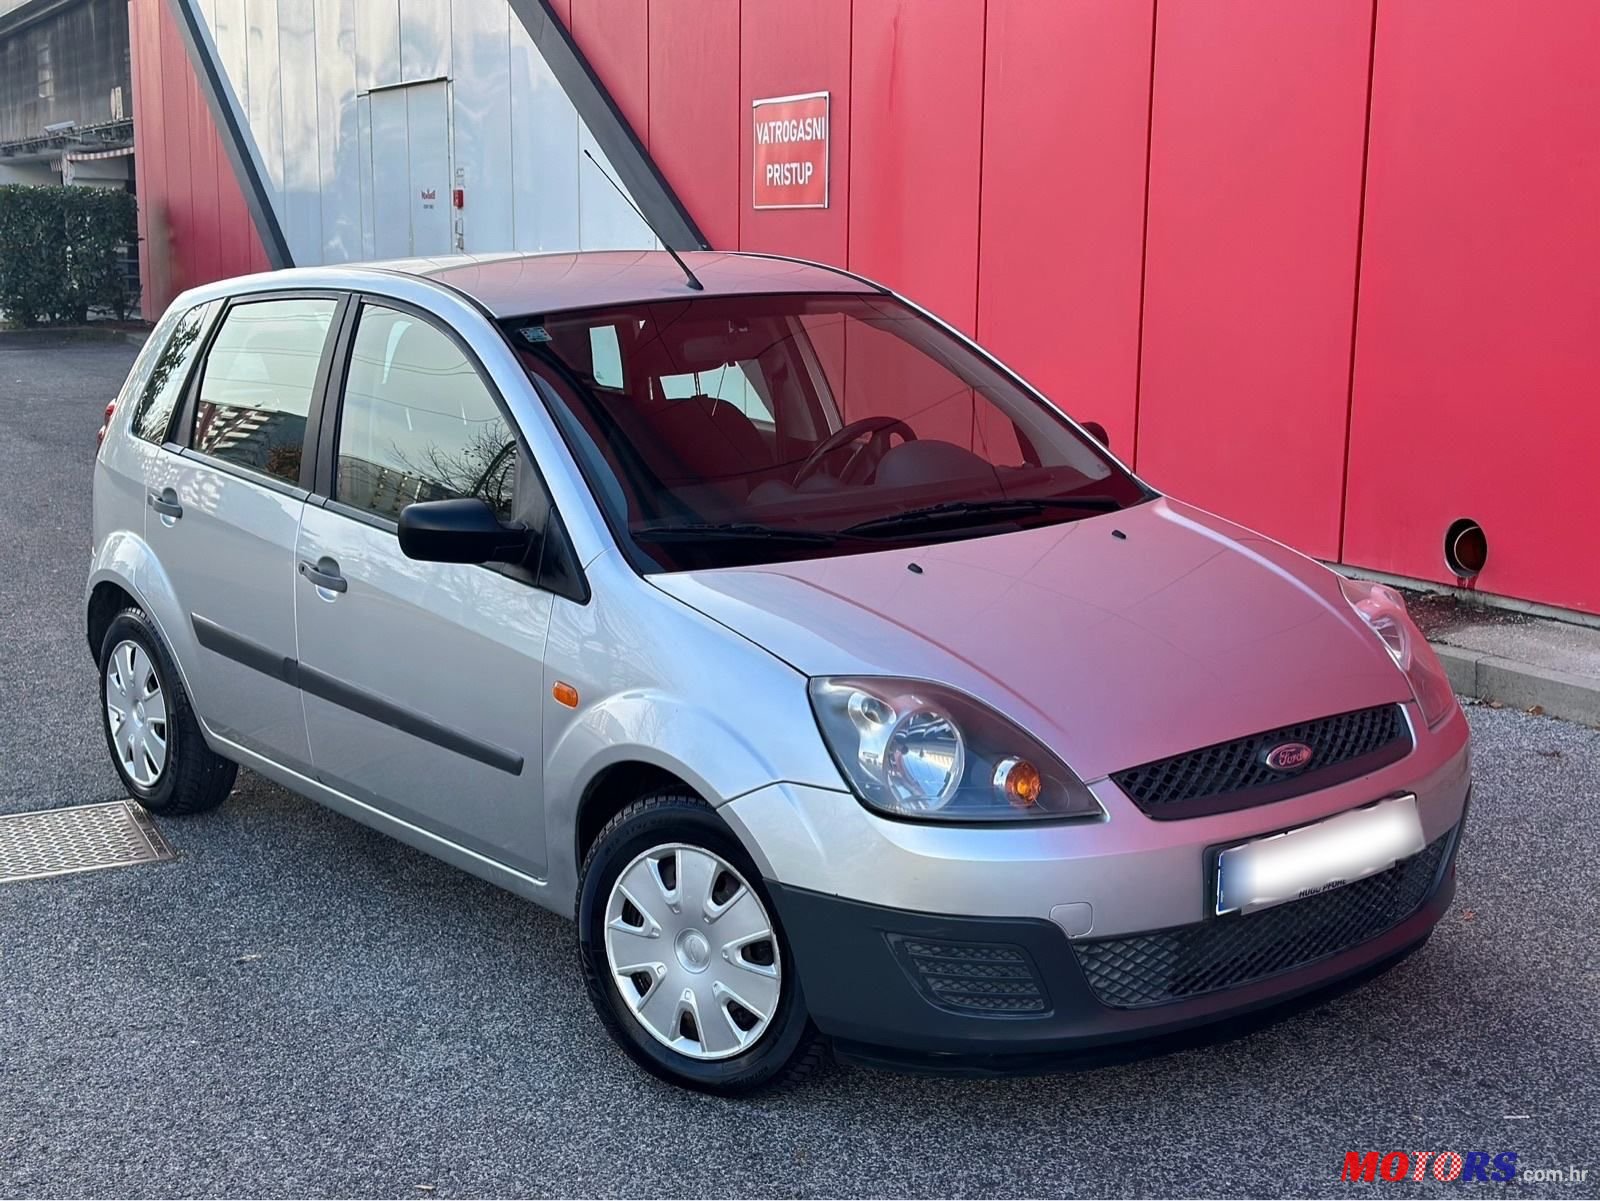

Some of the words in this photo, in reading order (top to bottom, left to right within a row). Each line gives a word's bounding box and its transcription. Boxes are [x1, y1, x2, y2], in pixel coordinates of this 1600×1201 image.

[756, 116, 825, 145] VATROGASNI
[766, 161, 813, 186] PRISTUP
[1279, 748, 1303, 766] Ford
